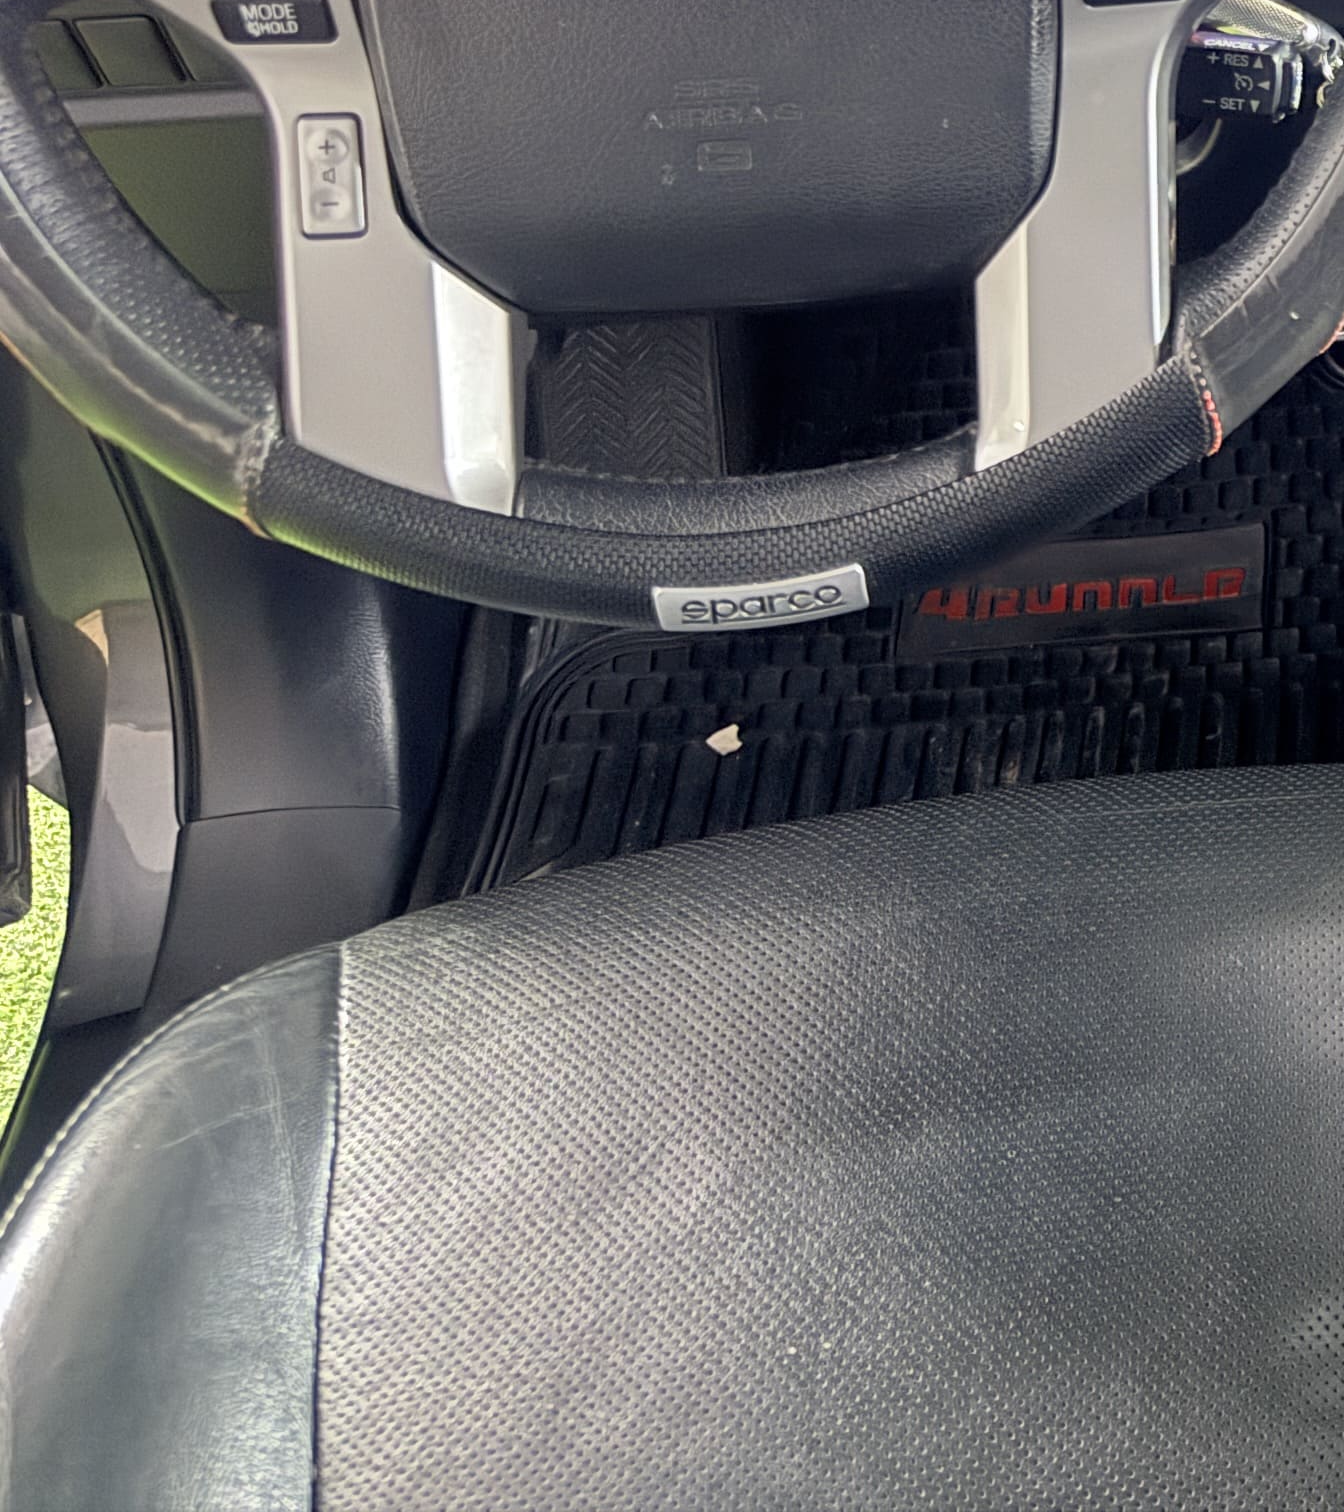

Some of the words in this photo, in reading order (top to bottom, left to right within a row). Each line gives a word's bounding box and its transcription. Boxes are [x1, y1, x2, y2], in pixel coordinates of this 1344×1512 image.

[239, 2, 297, 21] MODE
[260, 20, 299, 35] HOLD
[1223, 53, 1249, 67] RES
[1220, 97, 1245, 111] SET
[681, 584, 843, 625] sparco
